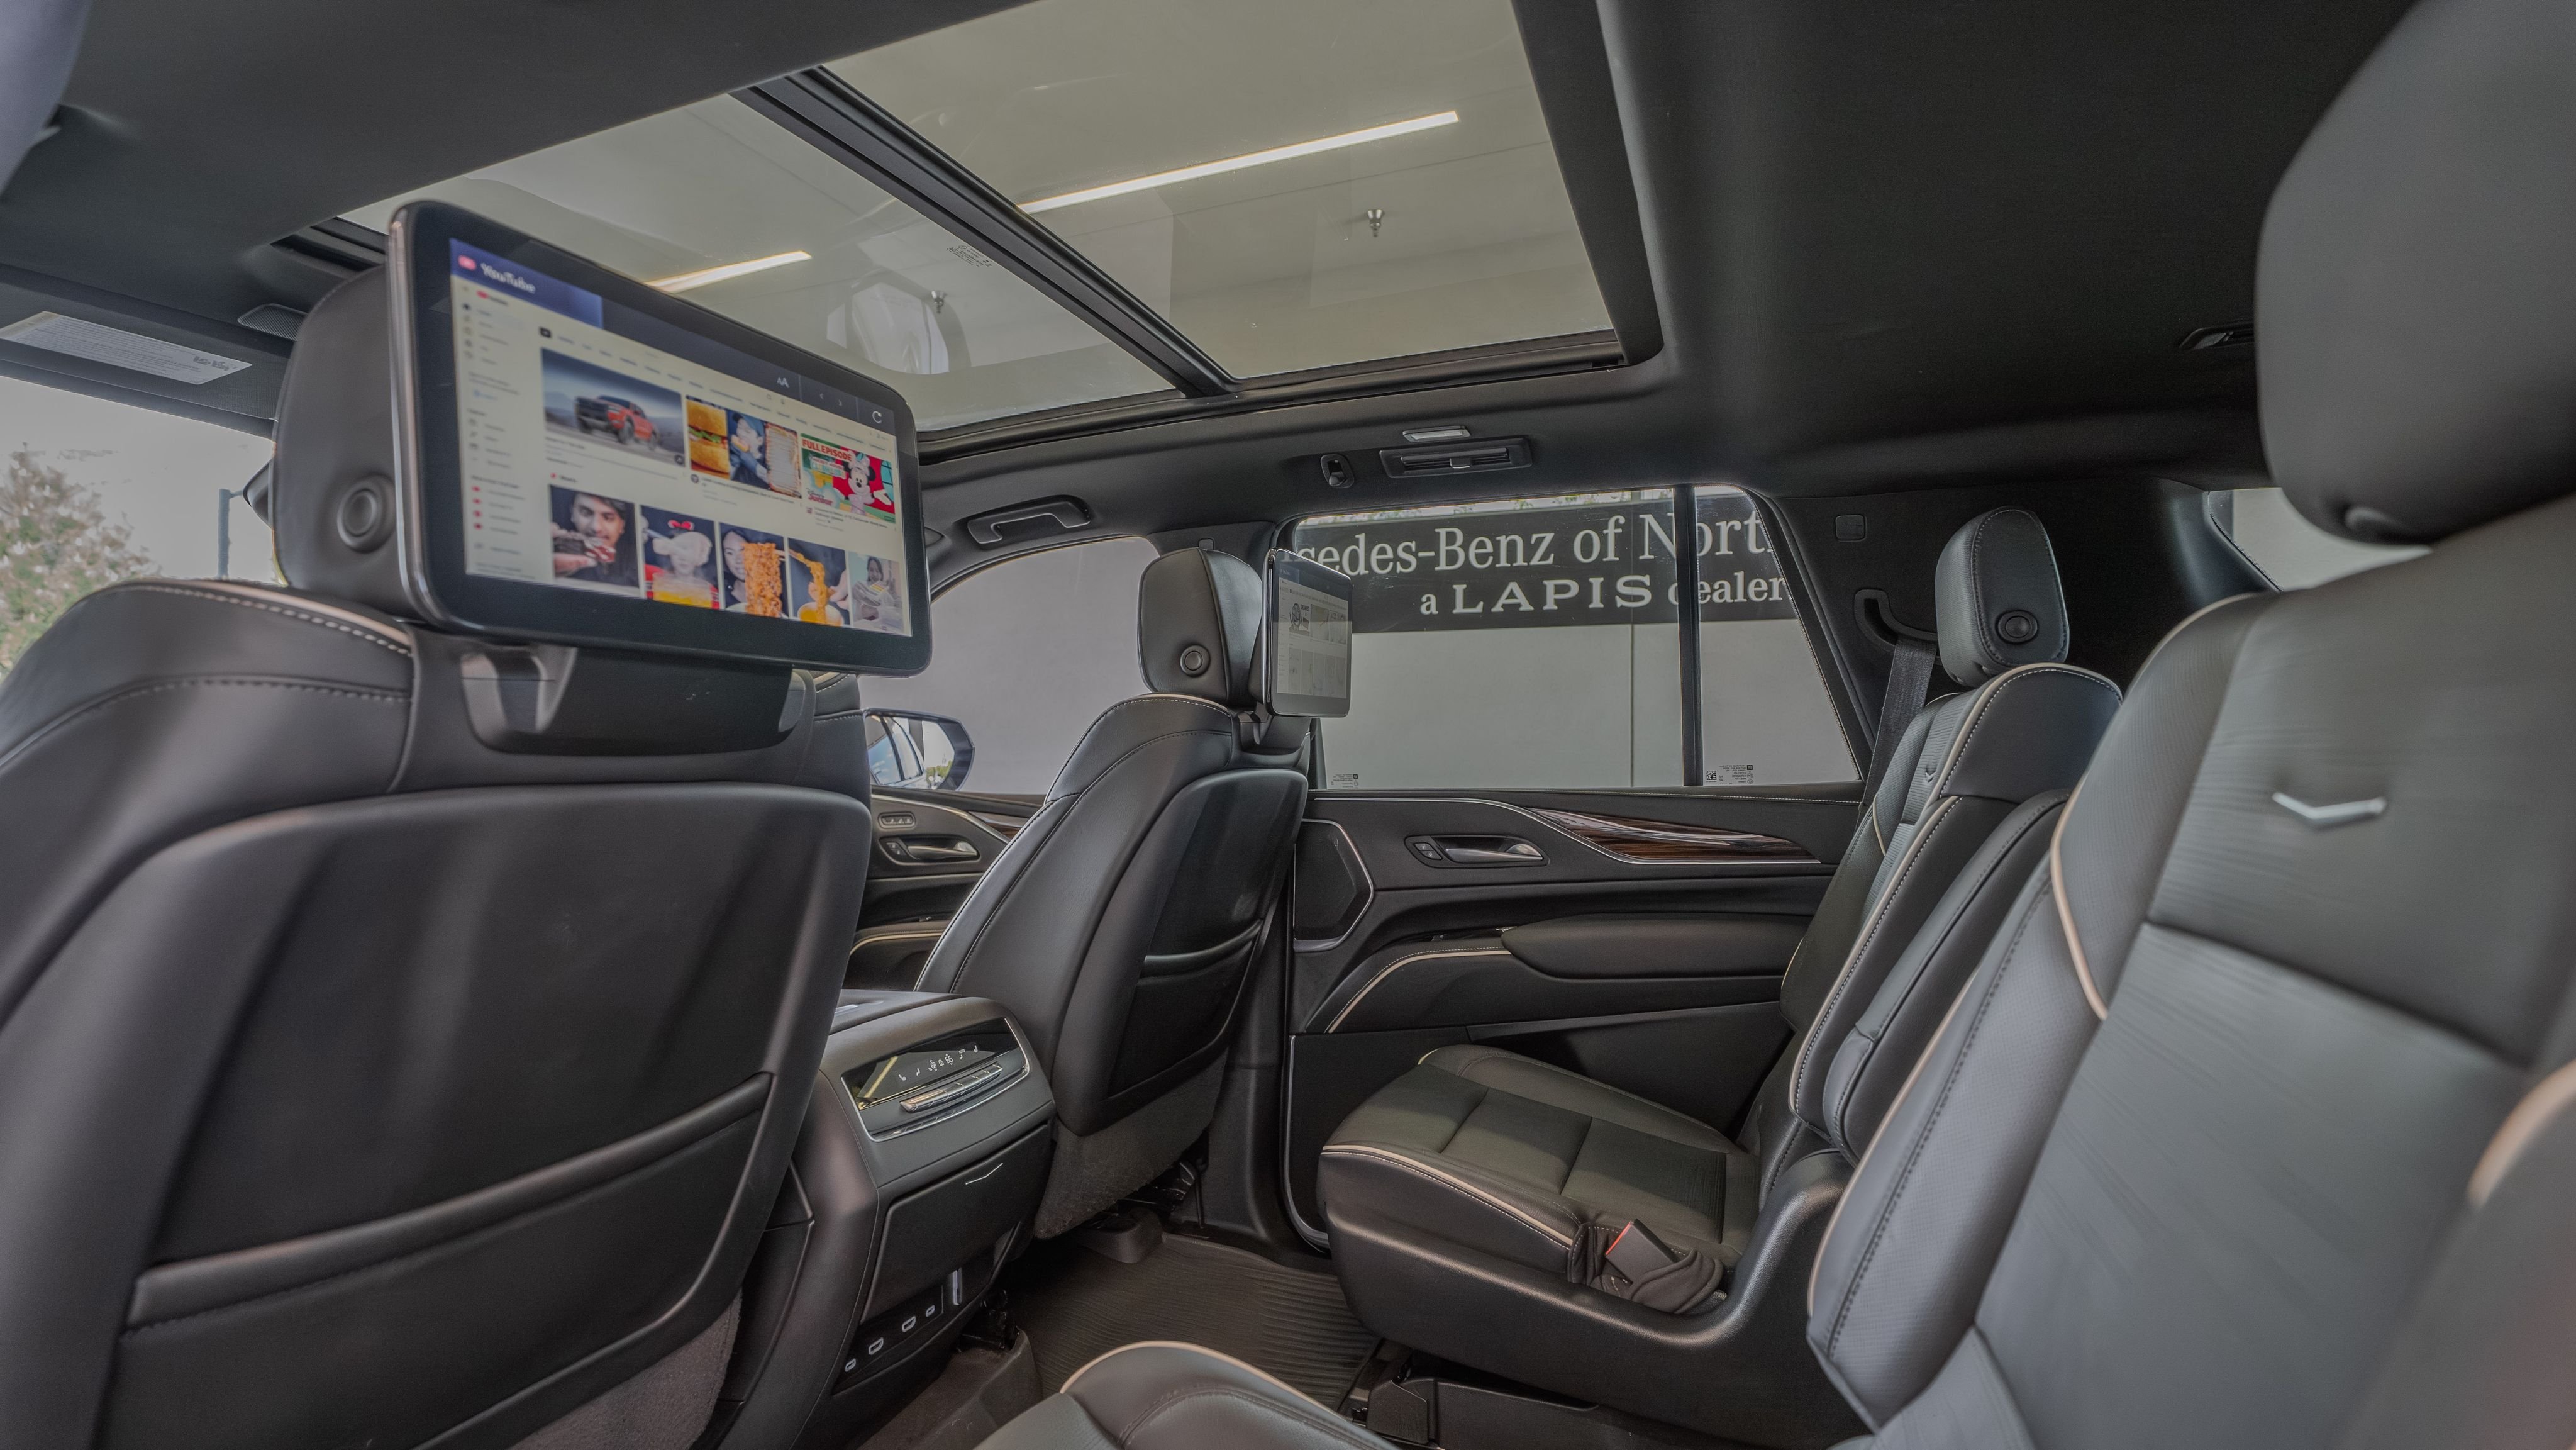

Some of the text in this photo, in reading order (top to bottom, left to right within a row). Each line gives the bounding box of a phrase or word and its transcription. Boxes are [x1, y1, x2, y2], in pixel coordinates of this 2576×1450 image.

[480, 262, 536, 293] YouTube
[802, 439, 820, 452] FULL
[821, 445, 852, 462] EPISODE
[1574, 515, 1626, 563] of
[1638, 510, 1774, 561] Nort
[1419, 593, 1439, 615] a
[1452, 574, 1652, 615] LAPIS
